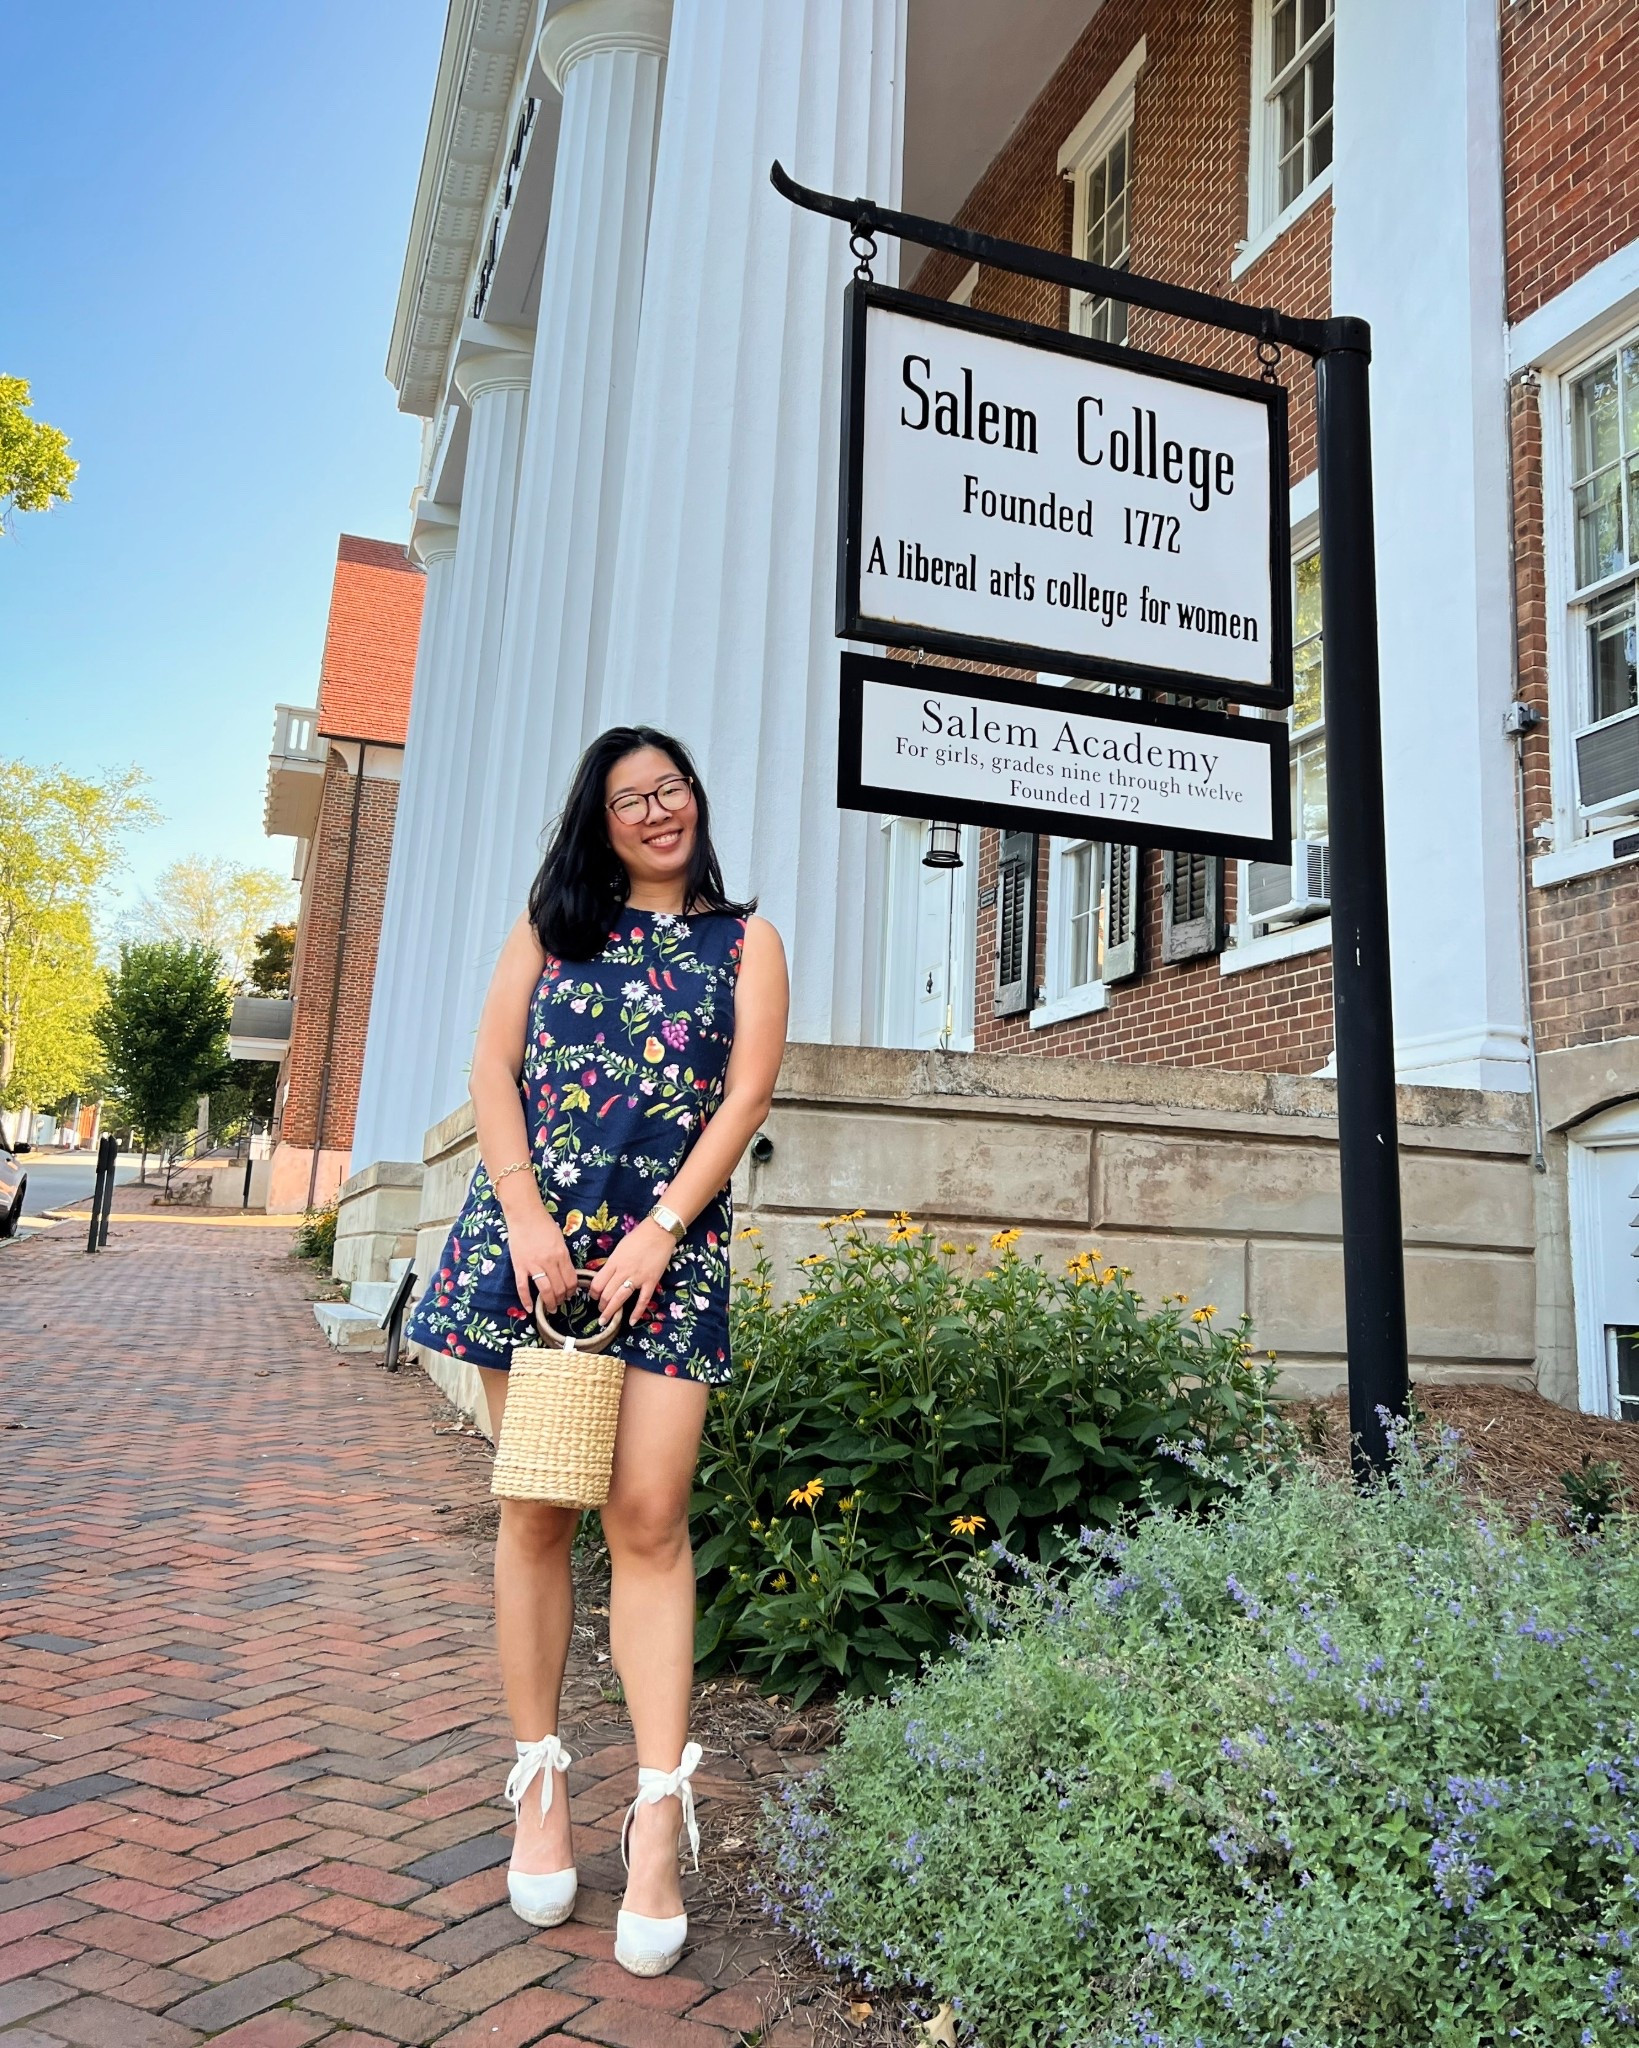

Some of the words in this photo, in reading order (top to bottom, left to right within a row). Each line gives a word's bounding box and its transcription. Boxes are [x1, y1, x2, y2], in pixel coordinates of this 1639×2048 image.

[900, 354, 1039, 455] Salem
[1077, 395, 1235, 512] College
[962, 473, 1094, 538] Founded
[1123, 507, 1182, 555] 1772
[865, 535, 889, 576] A
[897, 539, 977, 593] liberal
[989, 561, 1035, 602] arts
[1046, 571, 1128, 628] college
[1139, 585, 1171, 626] for
[1175, 602, 1259, 643] women
[895, 736, 928, 758] For
[935, 743, 986, 770] girls,
[991, 755, 1055, 777] grades
[1061, 762, 1102, 784] nine
[1108, 768, 1181, 799] through
[1187, 783, 1244, 804] twelve
[921, 699, 1039, 749] Salem
[1051, 721, 1220, 785] Academy
[1009, 779, 1091, 808] Founded
[1099, 792, 1141, 815] 1772
